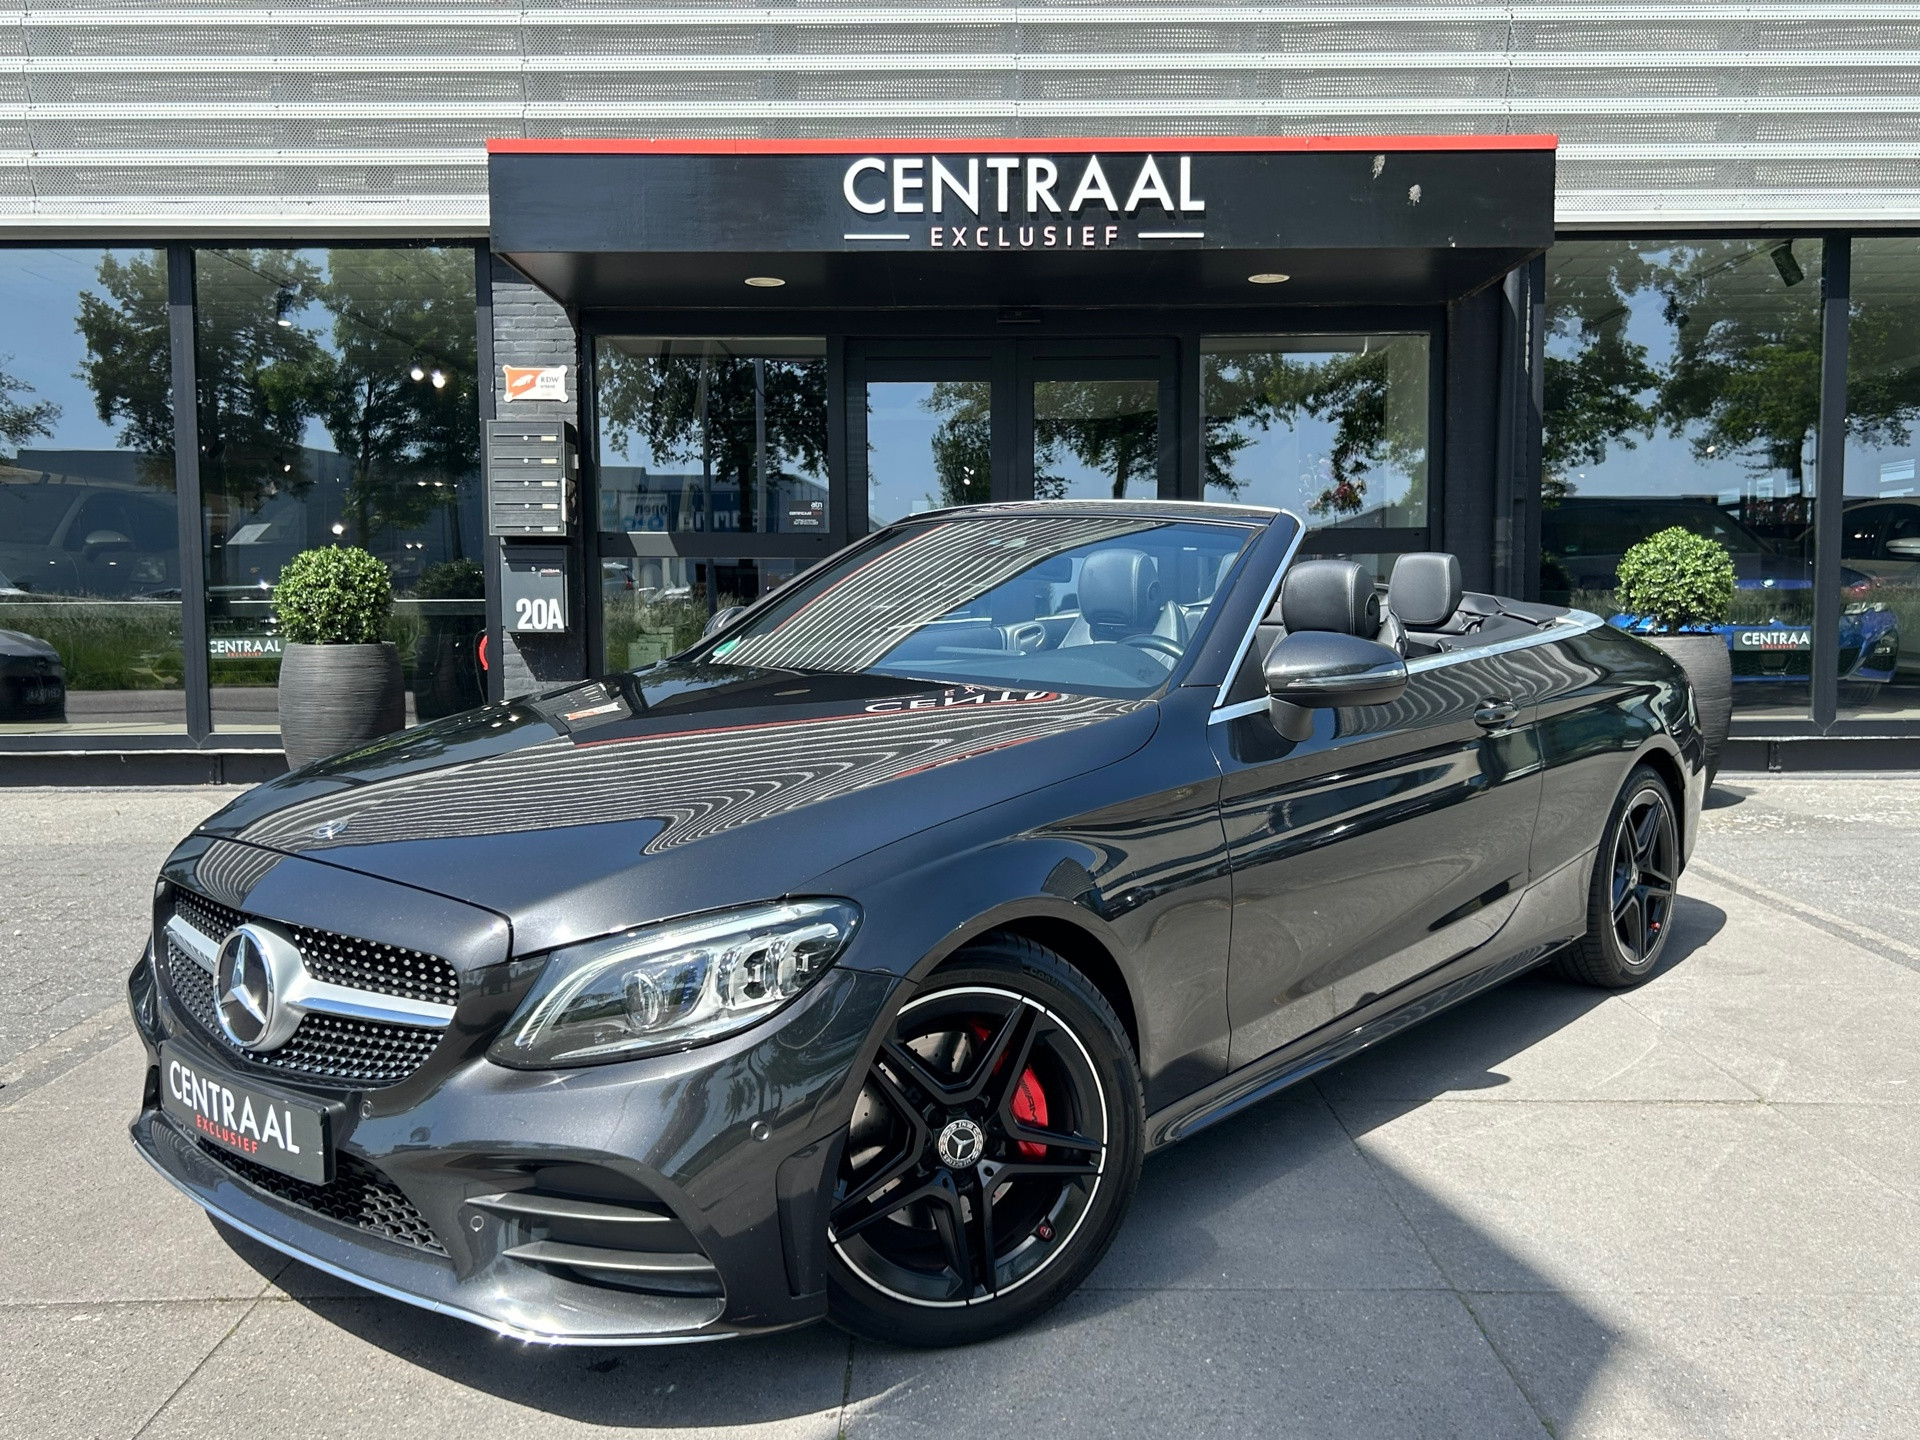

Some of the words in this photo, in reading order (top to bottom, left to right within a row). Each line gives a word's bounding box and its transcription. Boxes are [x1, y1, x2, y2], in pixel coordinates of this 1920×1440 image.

[842, 154, 1205, 215] CENTRAAL
[929, 225, 1120, 248] EXCLUSIEF
[540, 375, 560, 384] RDW
[515, 597, 565, 630] 20A
[209, 639, 282, 653] CENTRAAL
[1741, 632, 1810, 645] CENTRAA
[168, 1060, 300, 1155] CENTRAAL
[196, 1114, 259, 1154] EXCLUSIEF
